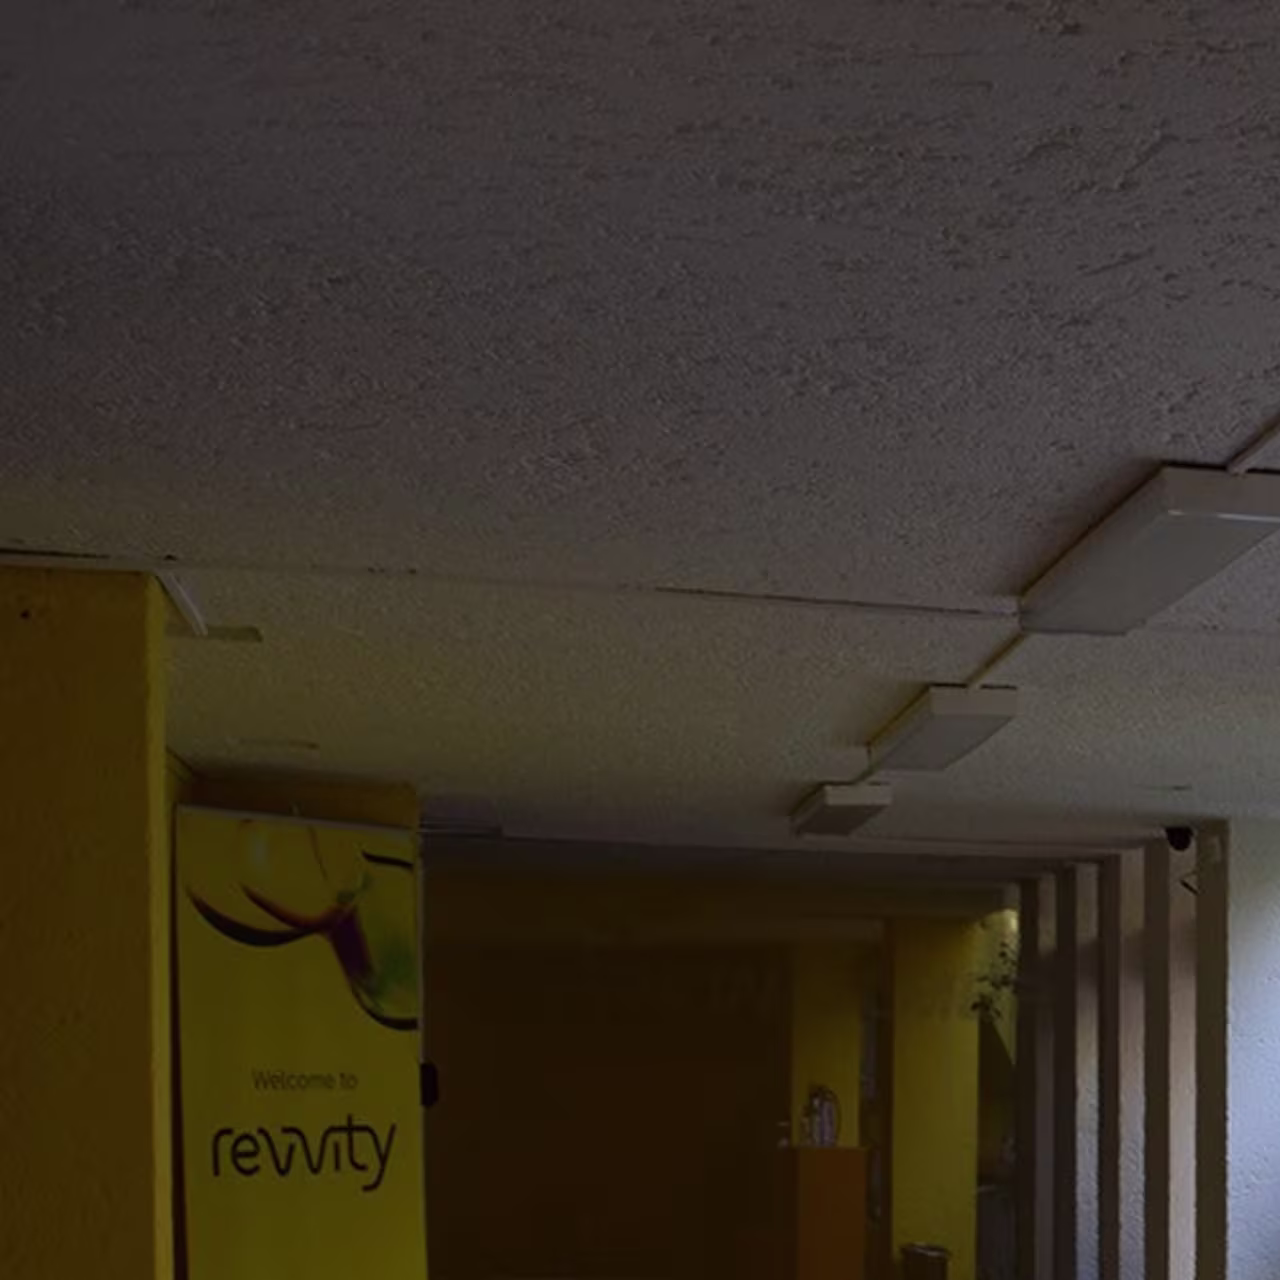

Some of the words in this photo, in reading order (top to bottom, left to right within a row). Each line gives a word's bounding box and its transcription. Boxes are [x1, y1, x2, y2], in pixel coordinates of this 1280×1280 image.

[252, 1069, 336, 1091] Welcome
[338, 1072, 359, 1091] to
[211, 1113, 397, 1192] revvity
